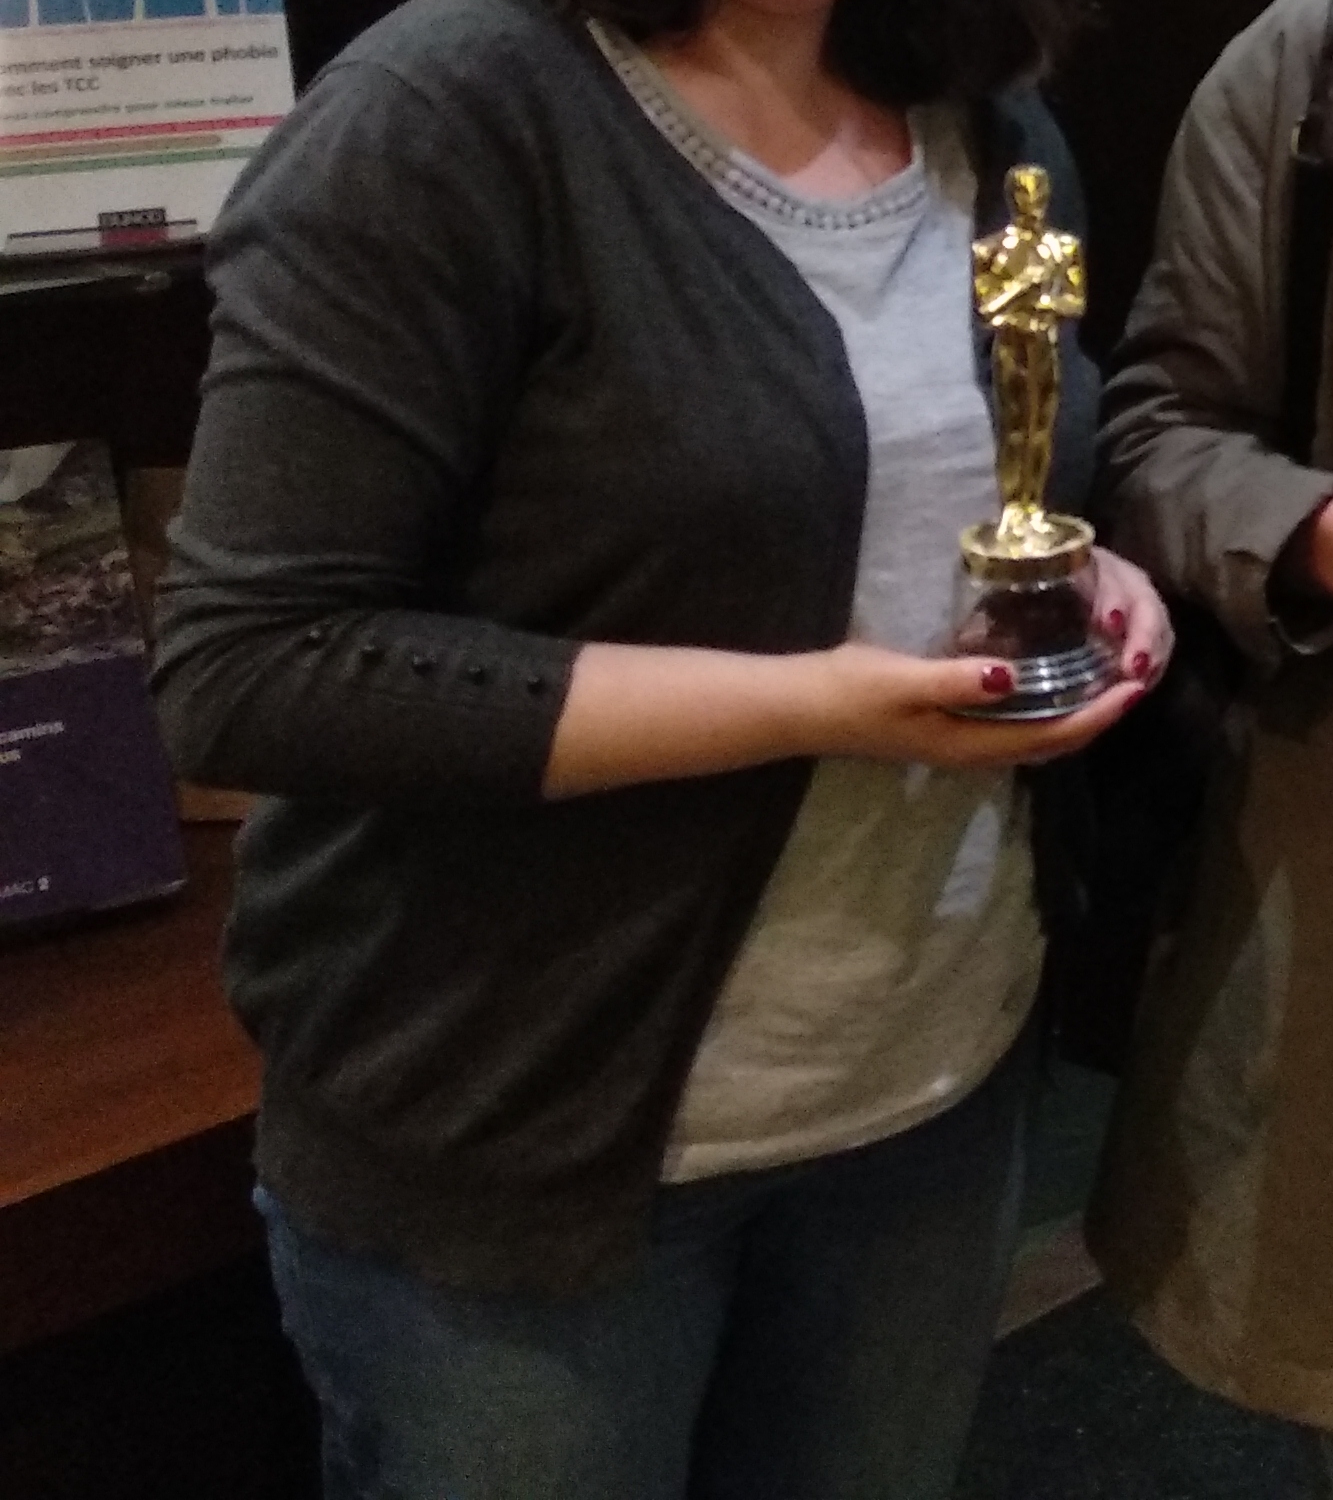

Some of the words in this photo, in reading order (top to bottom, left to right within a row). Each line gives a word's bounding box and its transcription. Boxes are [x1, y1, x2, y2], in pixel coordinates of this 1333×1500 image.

[168, 50, 206, 65] une
[211, 44, 279, 63] phobie
[64, 76, 100, 93] TCC
